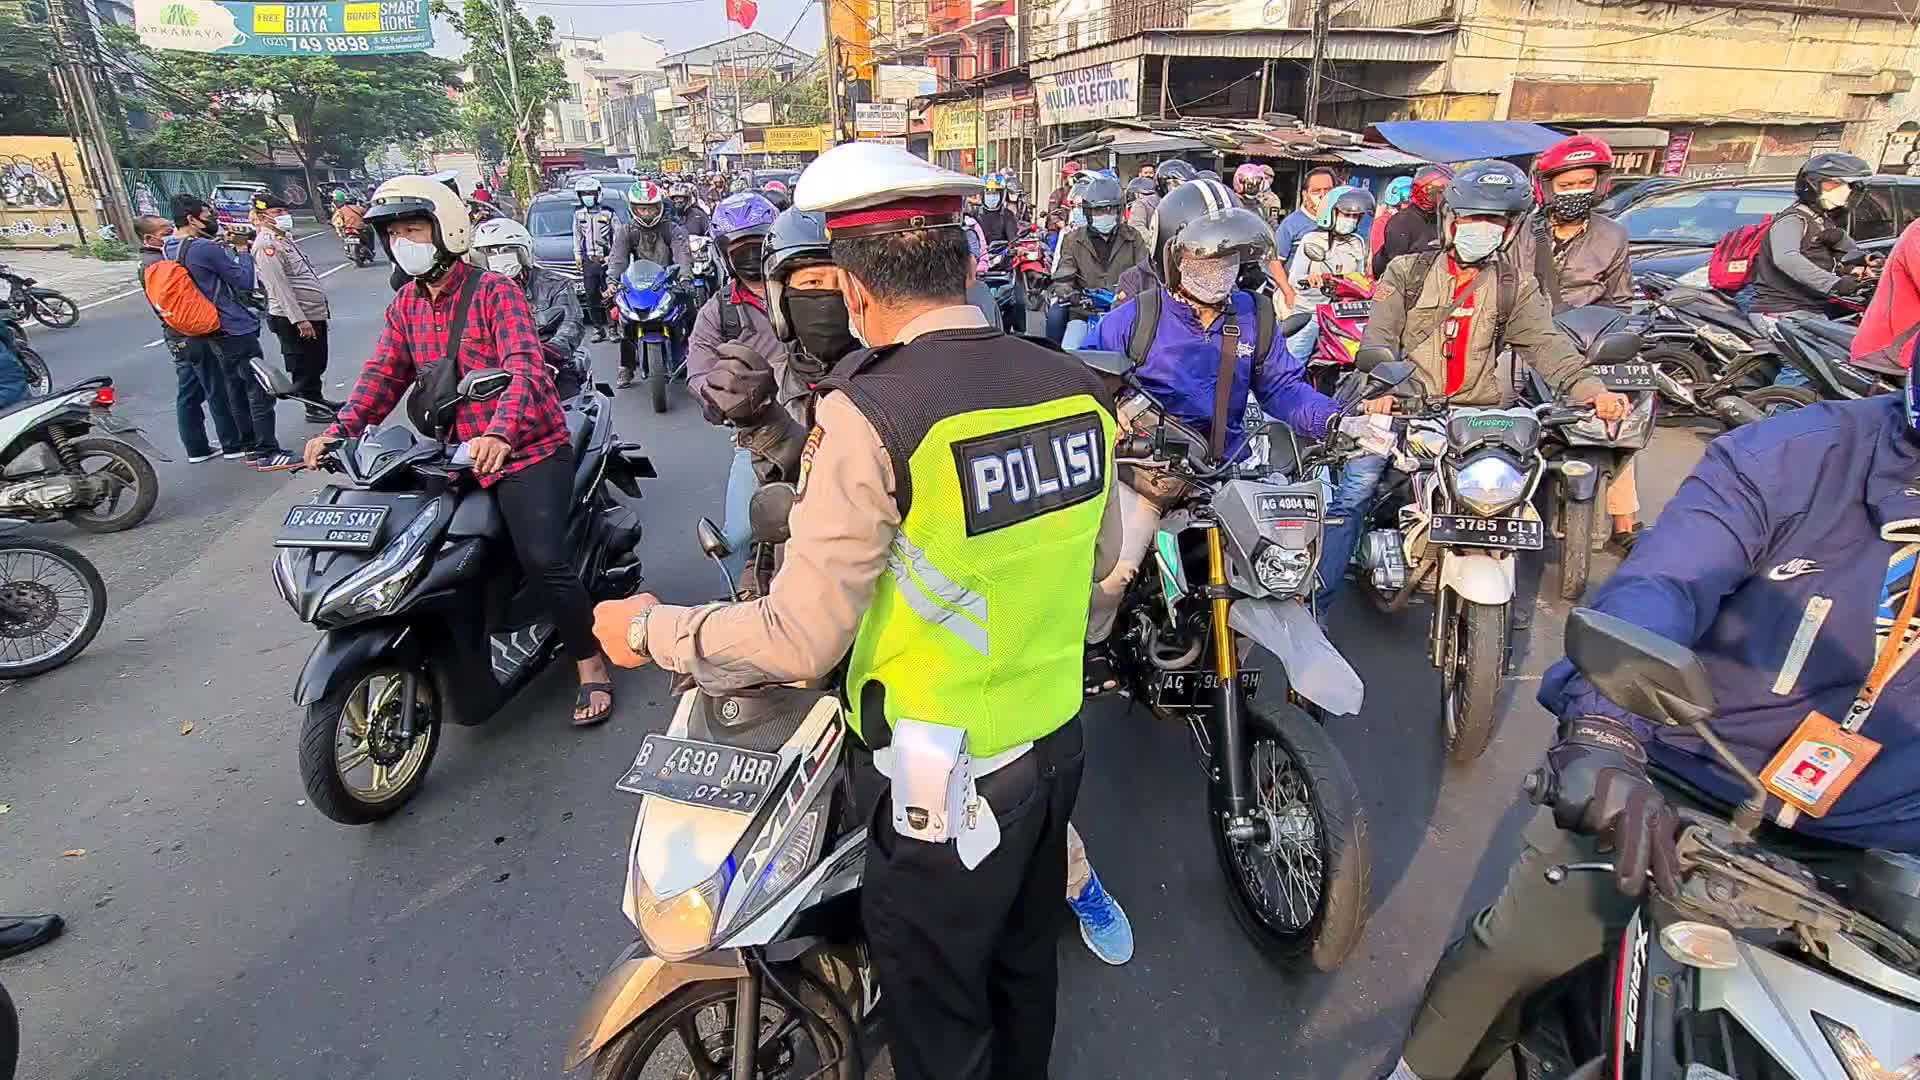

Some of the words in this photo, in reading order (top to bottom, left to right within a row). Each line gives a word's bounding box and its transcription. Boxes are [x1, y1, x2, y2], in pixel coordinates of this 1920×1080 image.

[286, 5, 328, 18] BIAYA
[380, 0, 421, 15] SMART
[257, 13, 281, 22] FREE
[346, 11, 377, 21] BONUS
[381, 14, 417, 31] HOME
[286, 18, 328, 32] BIAYA
[288, 36, 322, 52] 749
[326, 36, 369, 52] 8898
[1045, 86, 1077, 110] MULIA
[1077, 78, 1130, 105] ELECTRIC
[1624, 364, 1649, 375] TPR
[969, 428, 1101, 513] POLISI
[1261, 498, 1277, 510] AG
[290, 510, 303, 525] B
[346, 512, 380, 527] SMY
[1432, 517, 1442, 529] B
[1164, 675, 1185, 689] AG
[636, 743, 654, 767] B
[664, 746, 720, 777] 4698
[726, 754, 774, 785] NBR
